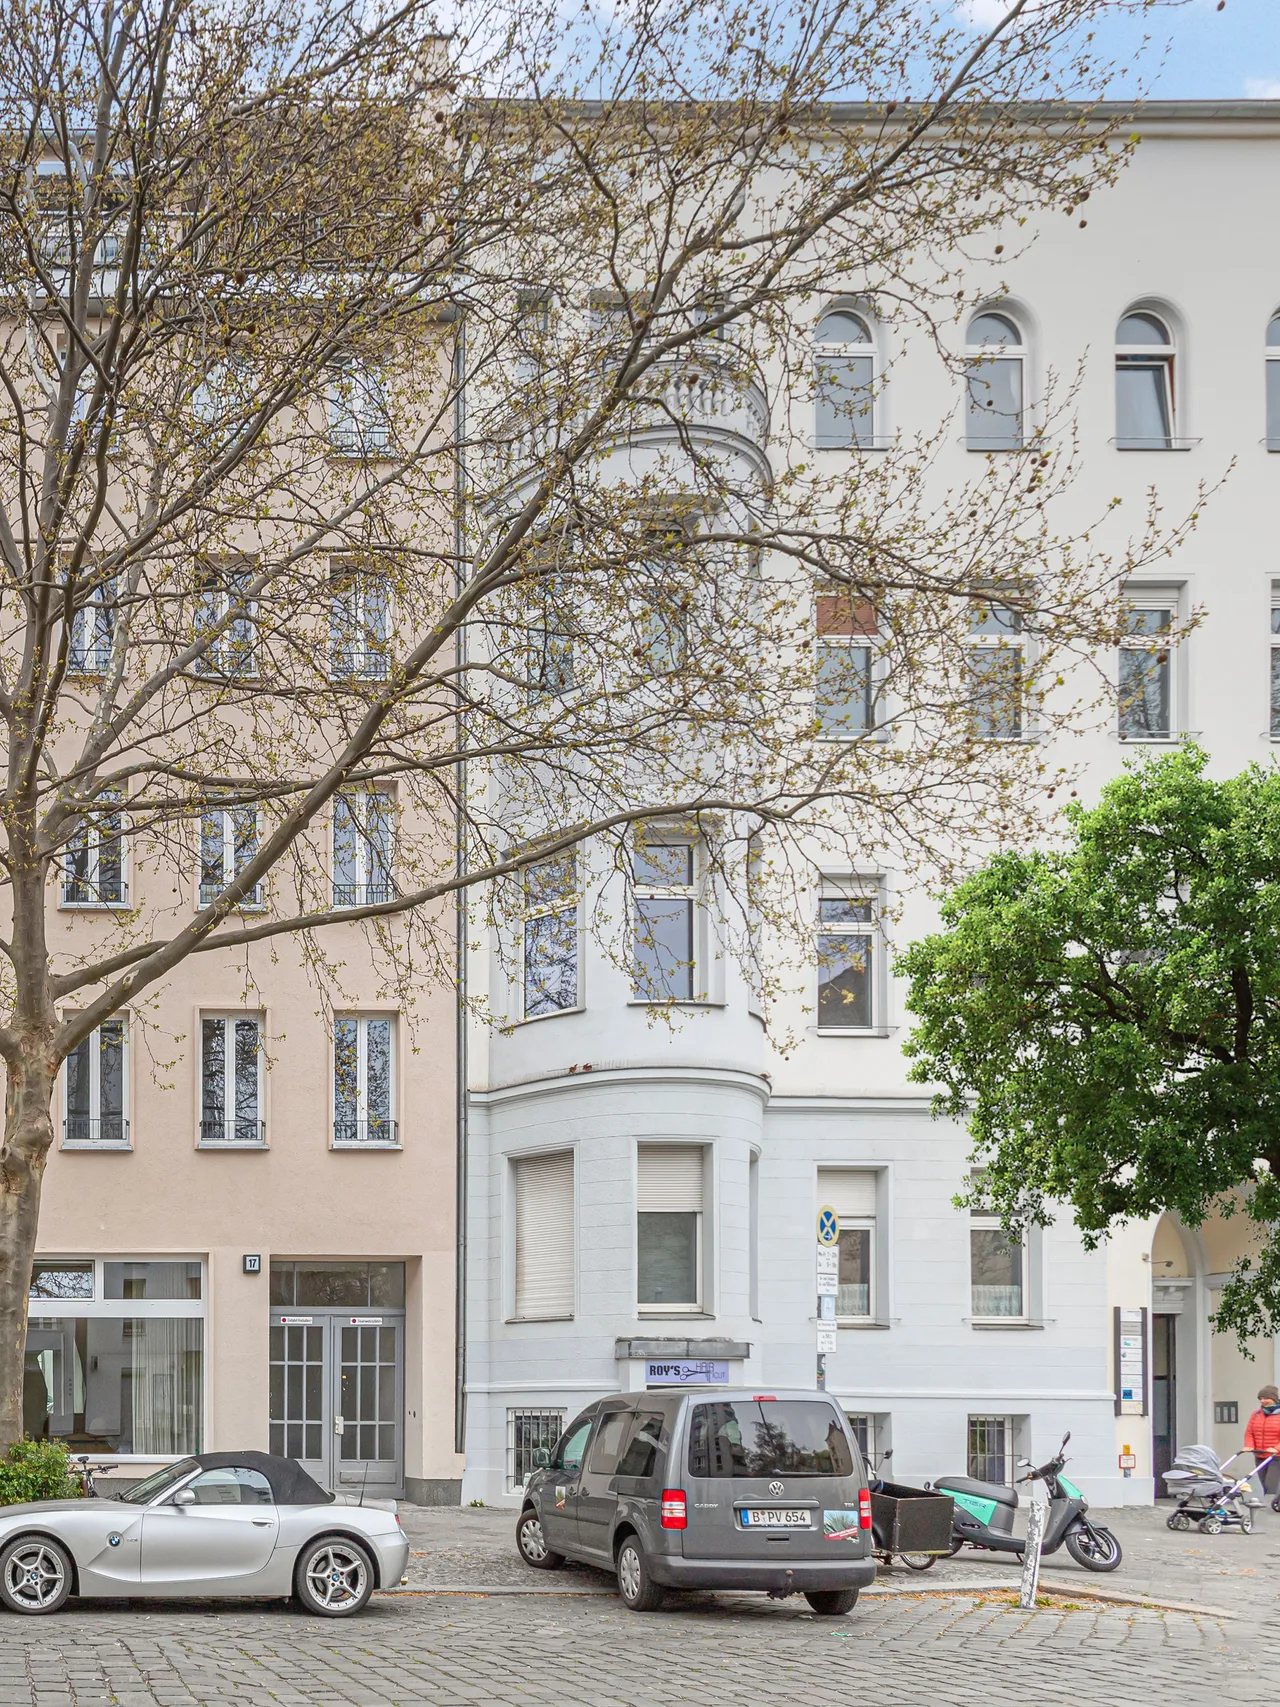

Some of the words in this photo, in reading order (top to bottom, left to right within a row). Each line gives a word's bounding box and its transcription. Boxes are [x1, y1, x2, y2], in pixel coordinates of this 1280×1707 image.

[248, 1258, 257, 1268] 17
[649, 1365, 681, 1376] ROY'S
[695, 1361, 715, 1372] HAIR
[753, 1511, 760, 1522] B
[768, 1511, 782, 1522] PV
[785, 1511, 806, 1522] 654
